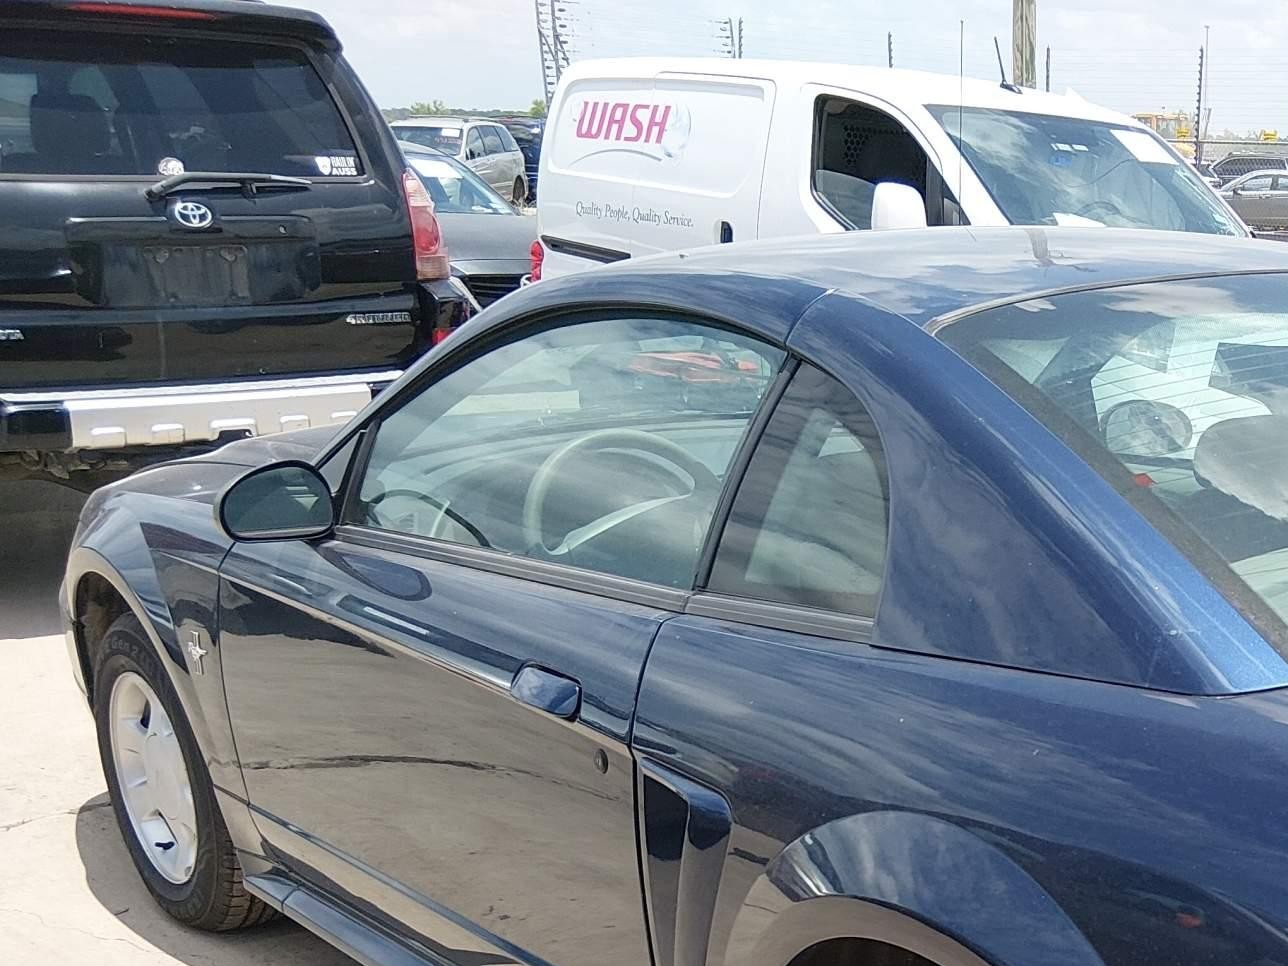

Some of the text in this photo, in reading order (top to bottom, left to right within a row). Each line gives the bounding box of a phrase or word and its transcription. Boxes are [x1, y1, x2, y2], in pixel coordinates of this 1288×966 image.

[576, 100, 672, 145] WASH
[575, 200, 694, 228] Quality People, Quality Service.
